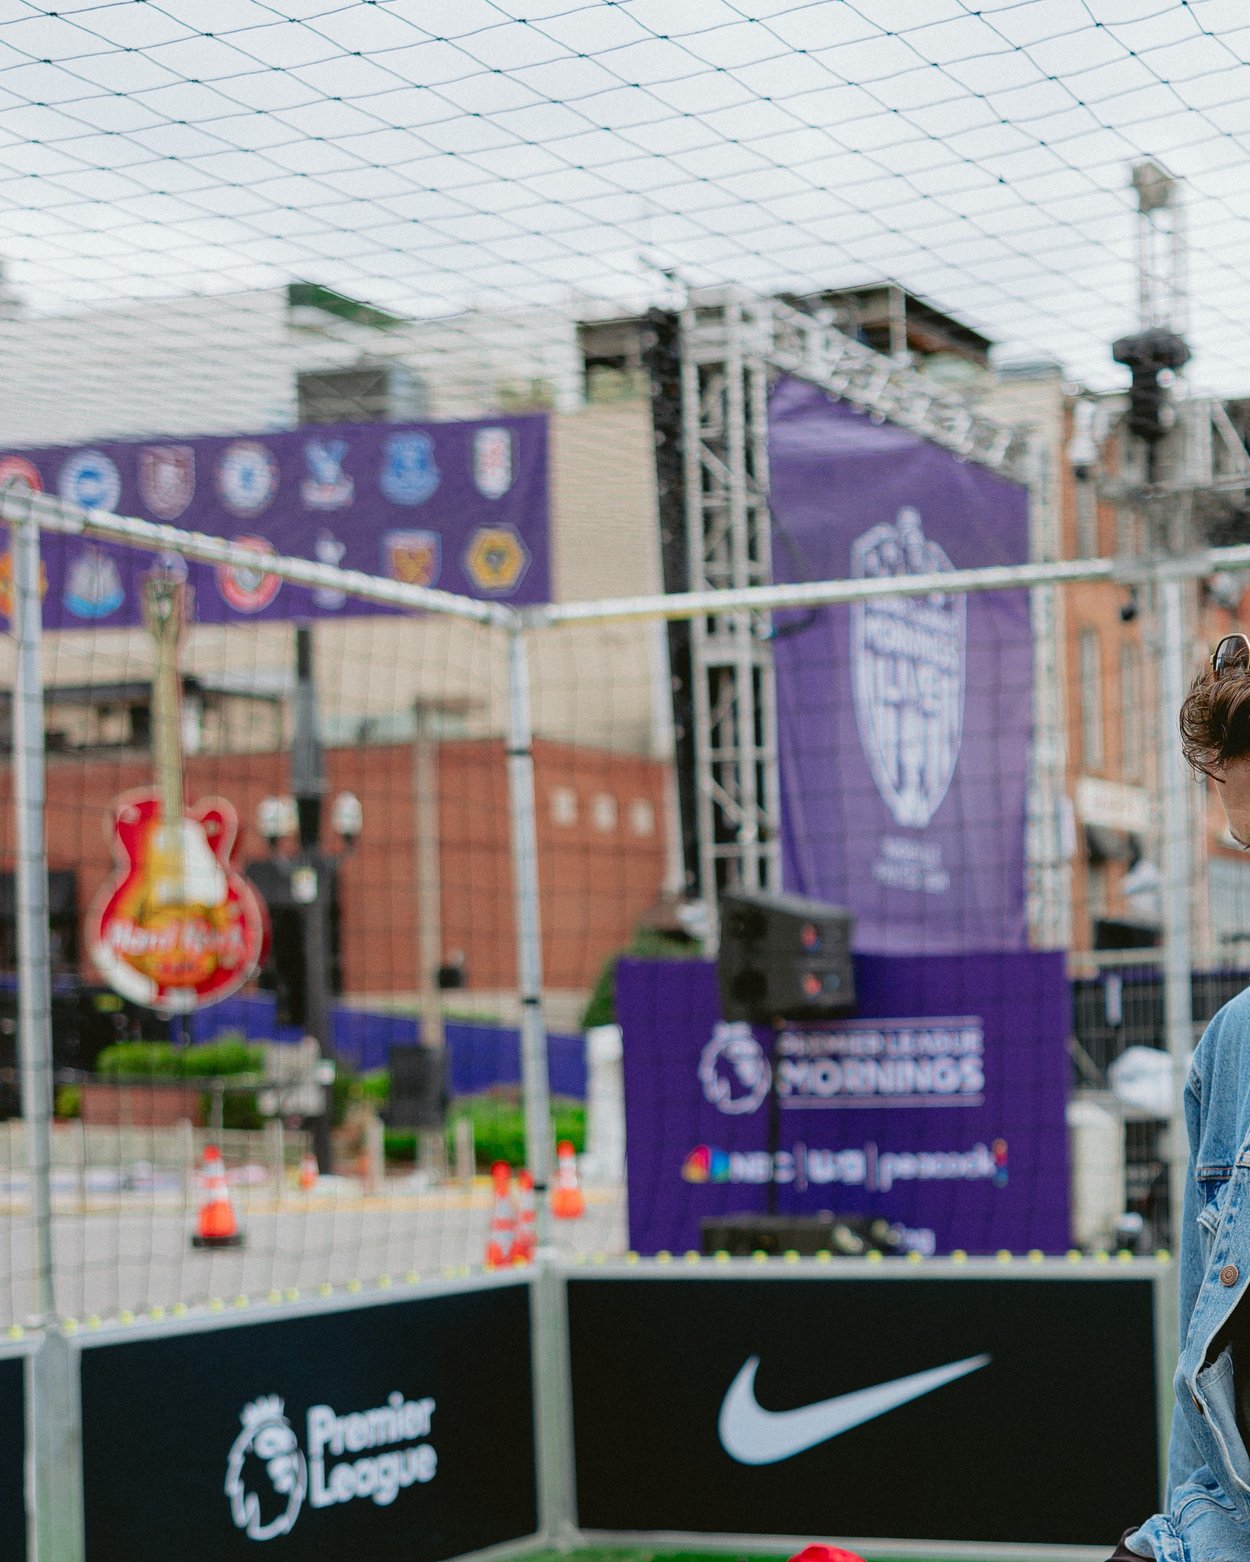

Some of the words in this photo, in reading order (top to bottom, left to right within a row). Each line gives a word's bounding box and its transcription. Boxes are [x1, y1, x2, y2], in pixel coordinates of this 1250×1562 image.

[776, 1056, 985, 1097] MORNINGS
[306, 1391, 436, 1456] Premier
[309, 1443, 438, 1508] League
